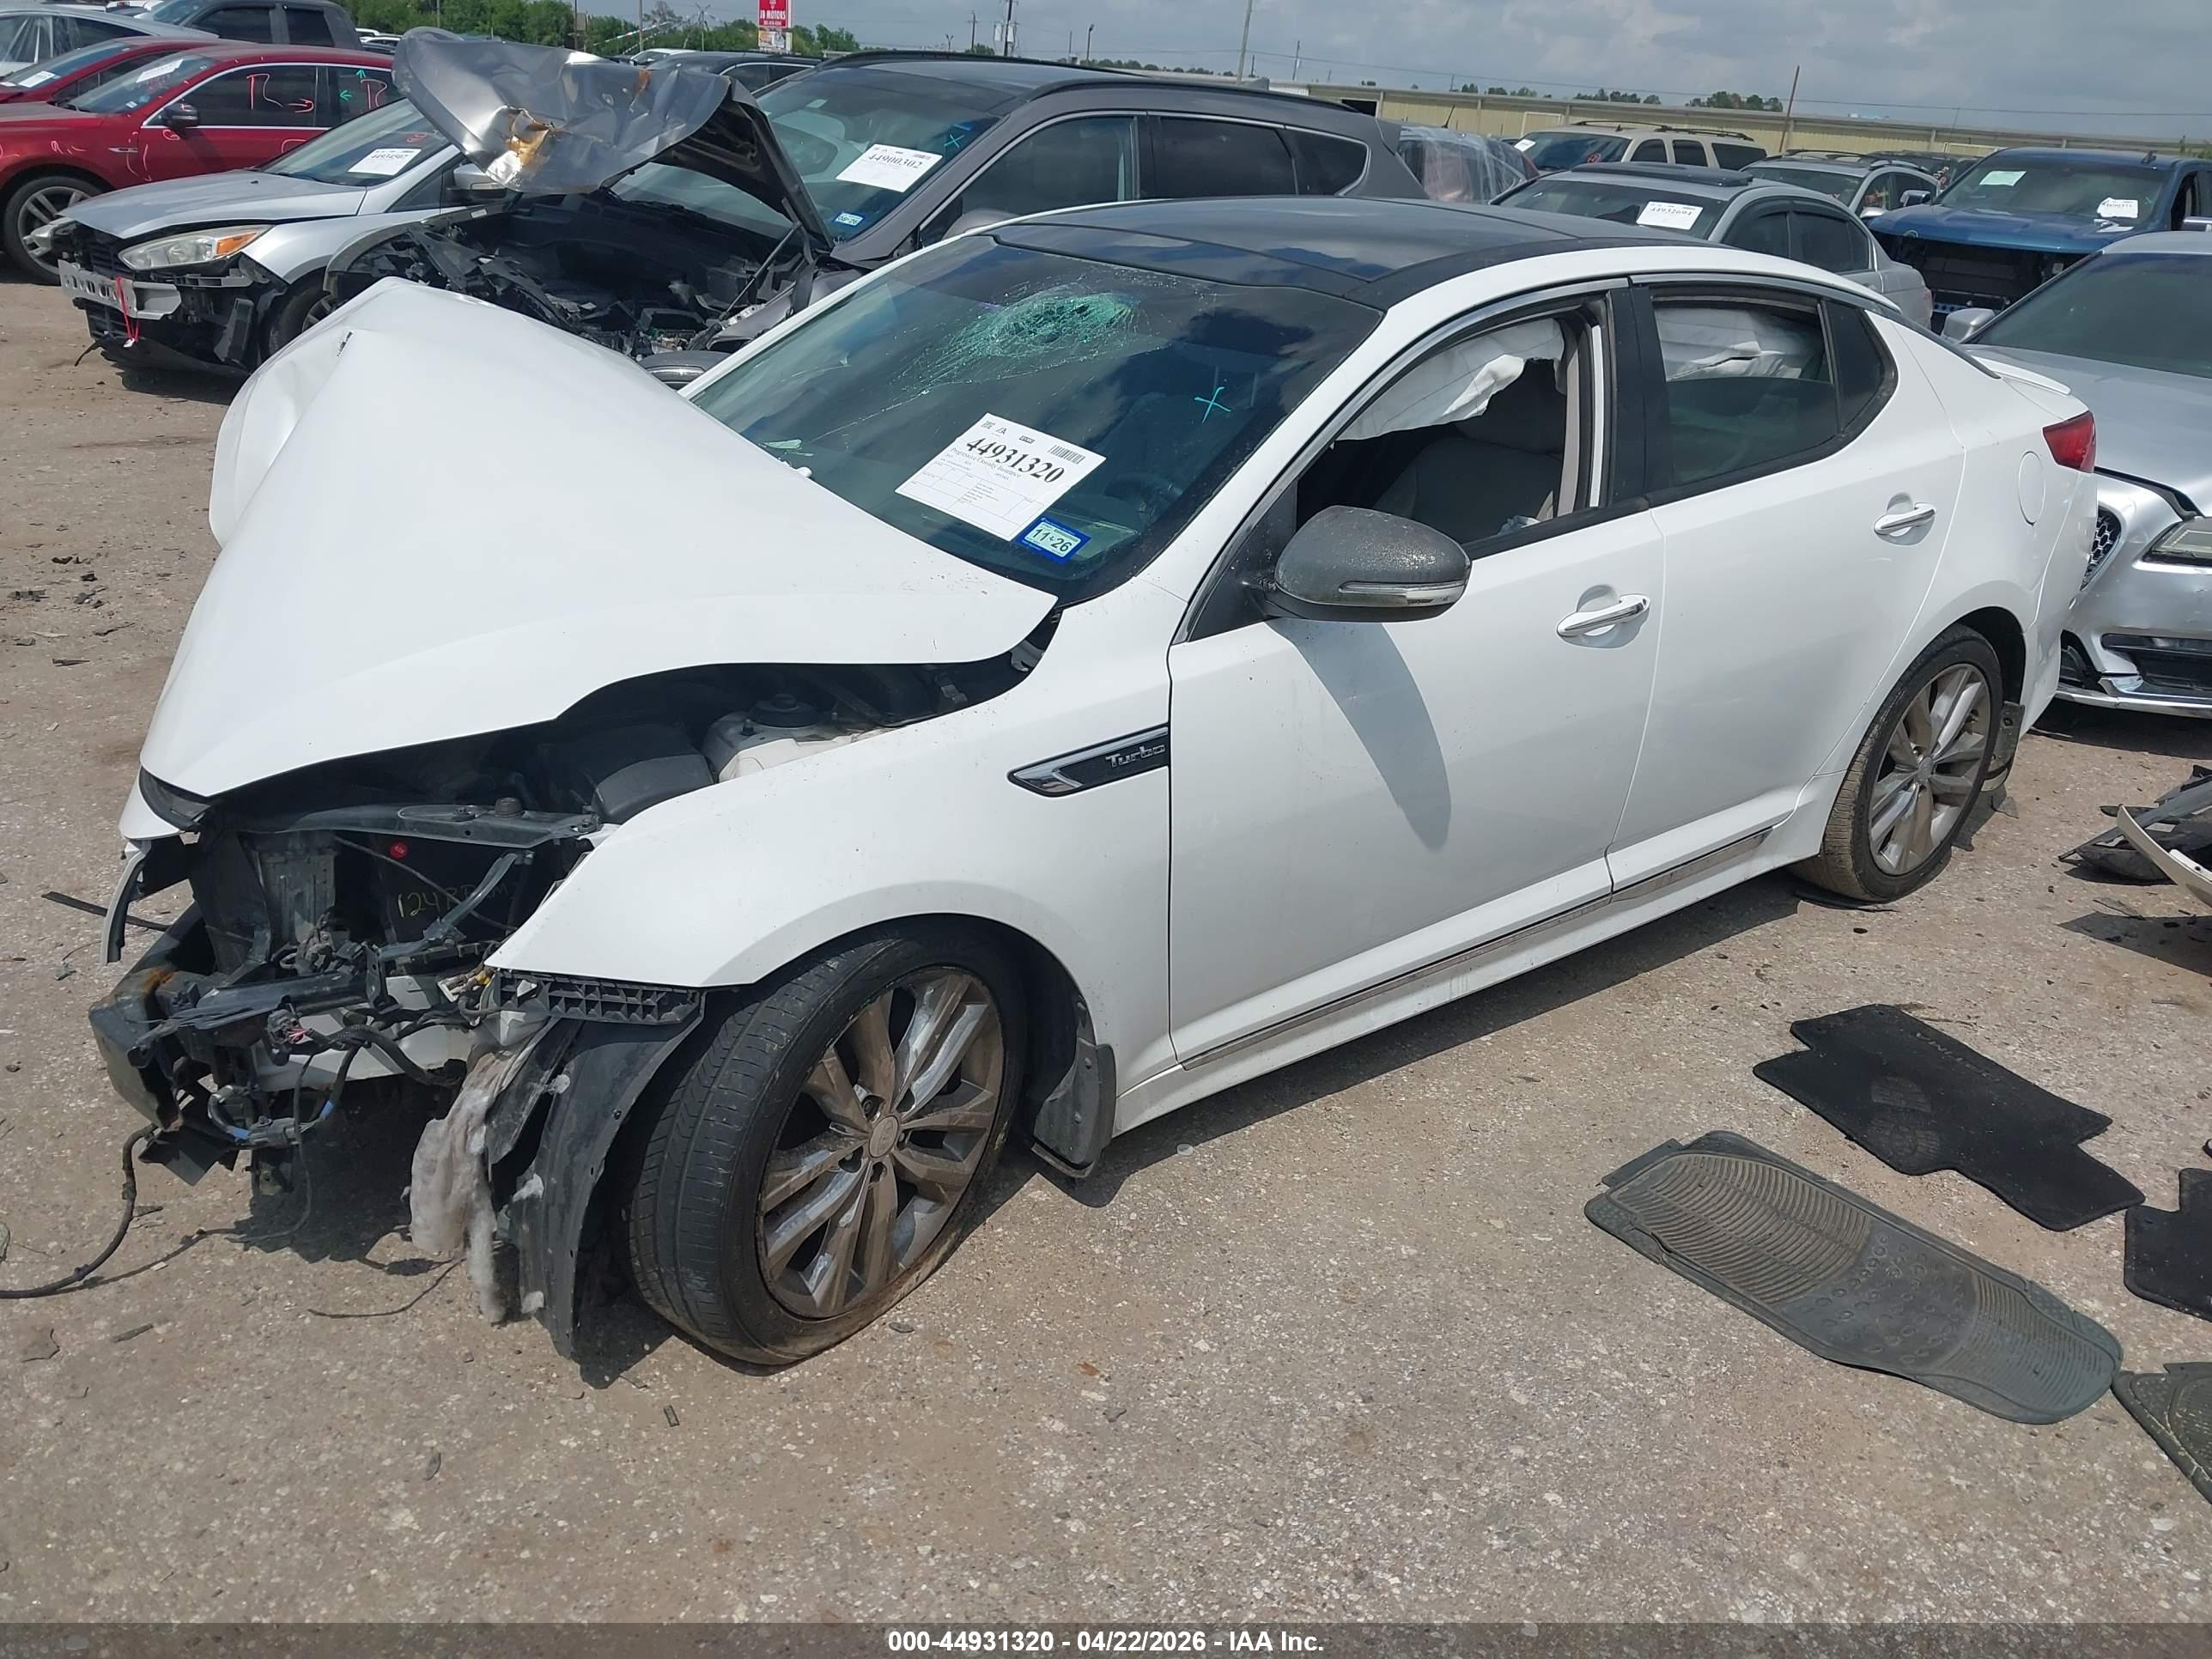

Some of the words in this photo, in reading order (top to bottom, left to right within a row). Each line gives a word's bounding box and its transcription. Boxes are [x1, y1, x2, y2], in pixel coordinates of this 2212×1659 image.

[766, 9, 786, 20] MOTORS
[966, 437, 1066, 483] 44931320
[1105, 744, 1166, 768] Turbo
